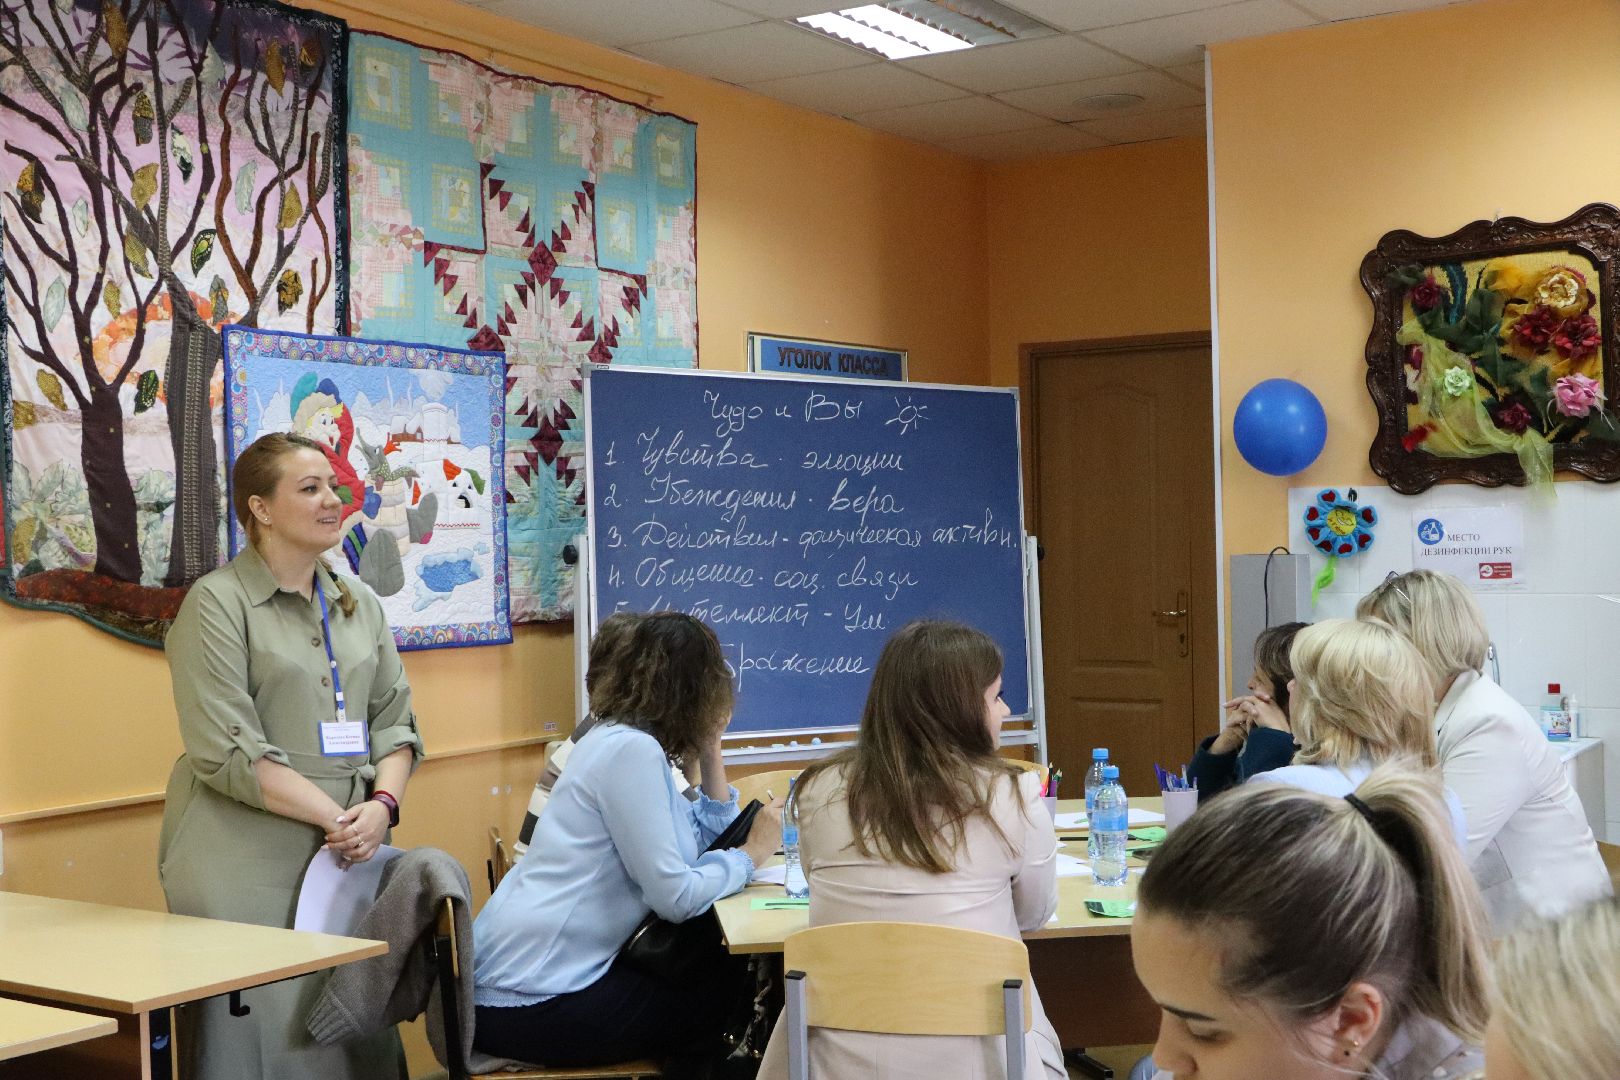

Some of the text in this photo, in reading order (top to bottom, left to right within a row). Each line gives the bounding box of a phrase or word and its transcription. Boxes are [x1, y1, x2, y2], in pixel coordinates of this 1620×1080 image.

[777, 346, 888, 376] УГОЛОК КЛАССА
[703, 389, 863, 438] Чудо и Вы
[637, 426, 769, 475] Чувства
[1420, 546, 1513, 557] ДЕЗИНФЕКЦИИ РУК
[1447, 533, 1481, 542] МЕСТО
